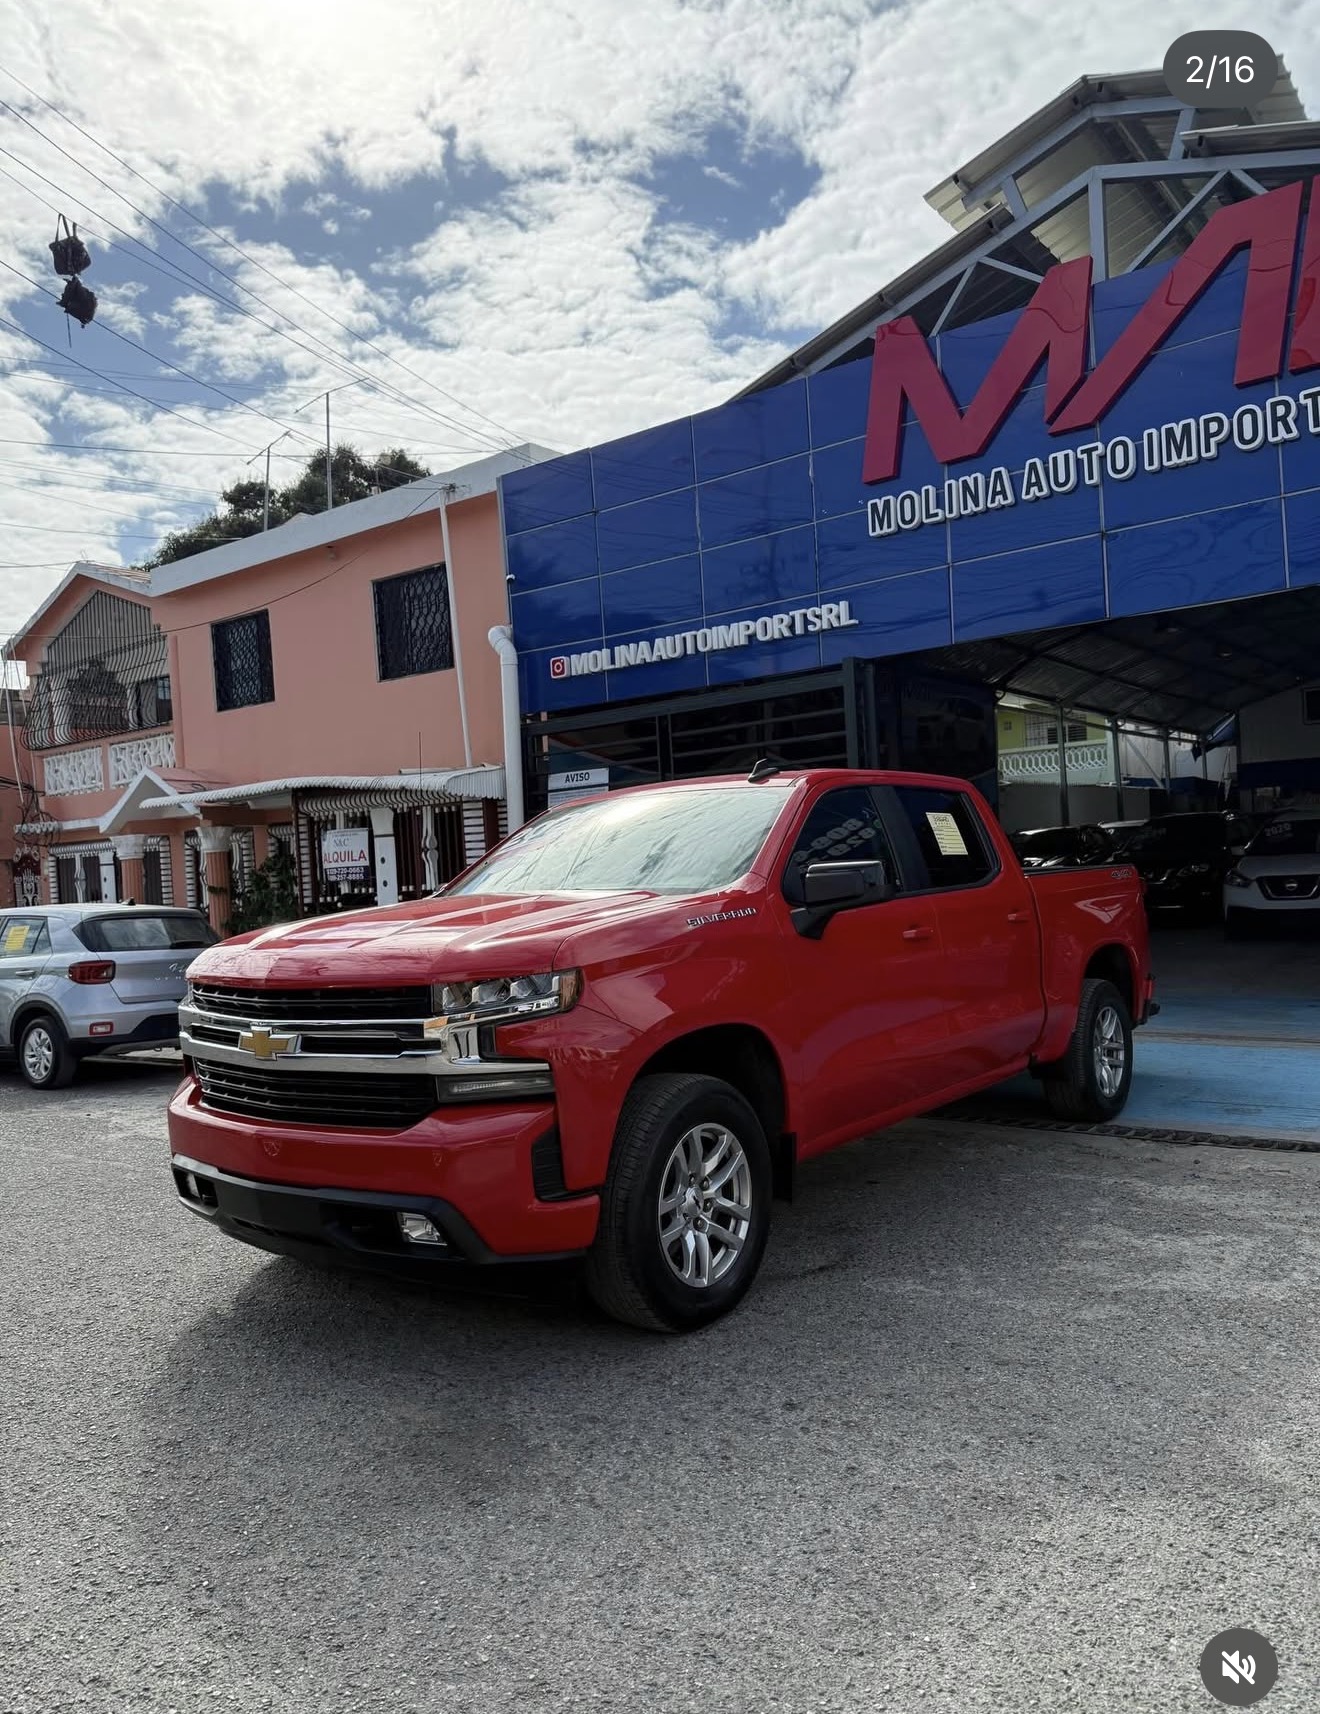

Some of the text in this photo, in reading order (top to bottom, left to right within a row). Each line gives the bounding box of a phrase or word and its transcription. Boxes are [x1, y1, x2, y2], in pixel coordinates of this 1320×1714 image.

[867, 466, 1016, 538] MOLINA
[1021, 436, 1137, 502] AUTO
[570, 600, 859, 677] MOLINAAUTOIMPORTSRL
[565, 772, 591, 783] AVISO
[323, 849, 367, 864] ALQUILA
[687, 907, 757, 927] SILVERADO
